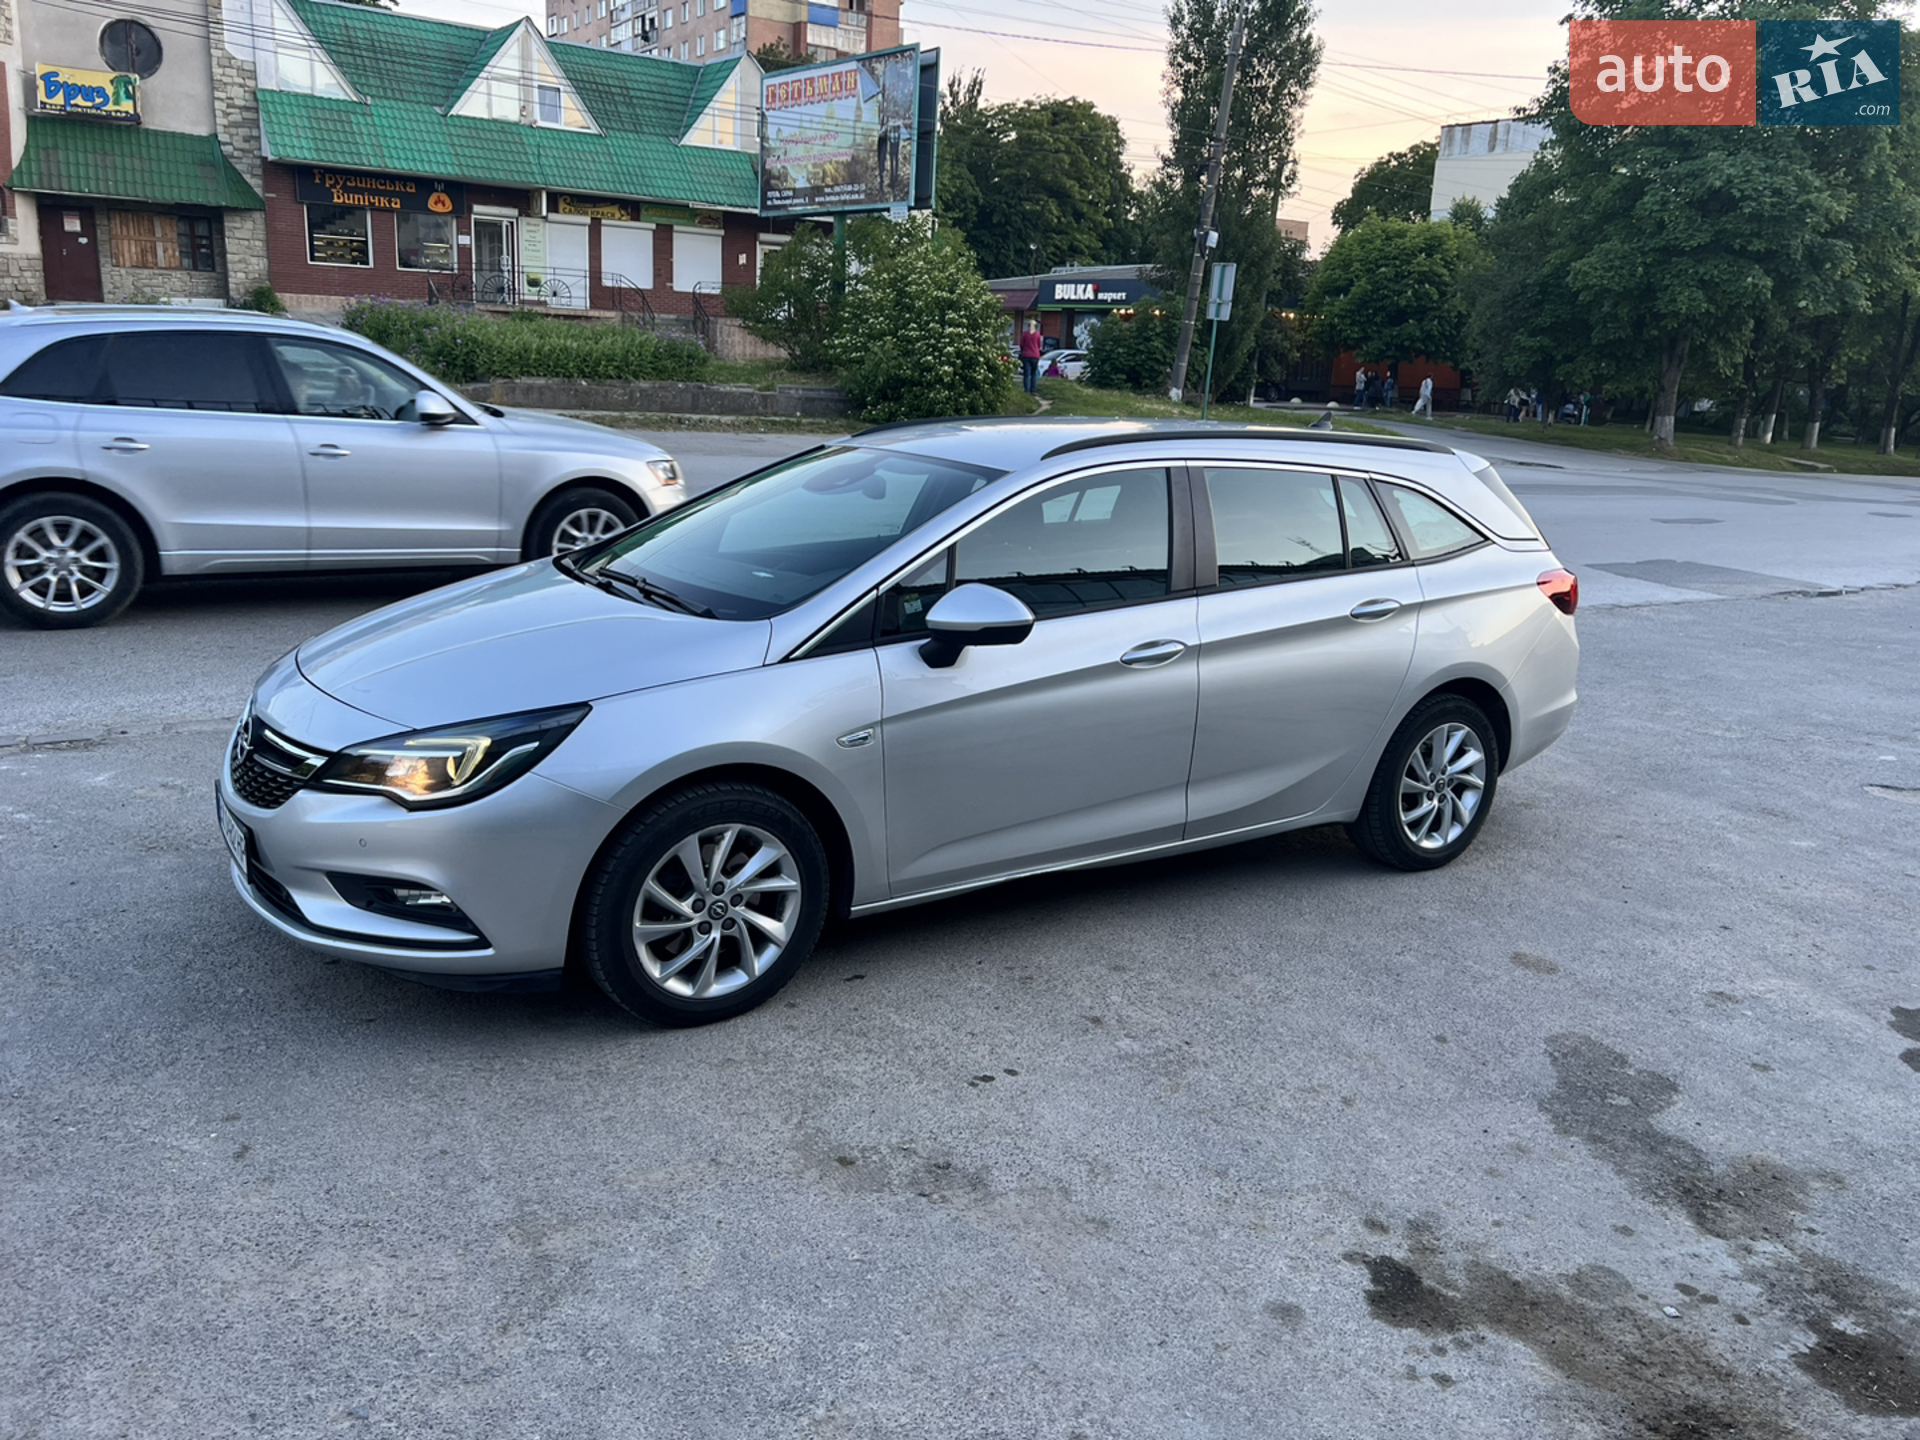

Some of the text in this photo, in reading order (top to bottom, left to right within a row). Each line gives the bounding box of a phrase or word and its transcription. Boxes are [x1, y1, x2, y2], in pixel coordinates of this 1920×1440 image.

[40, 71, 110, 109] Бриз
[313, 169, 416, 193] Грузинська
[331, 188, 401, 209] Випічка
[1054, 283, 1095, 300] BULKA
